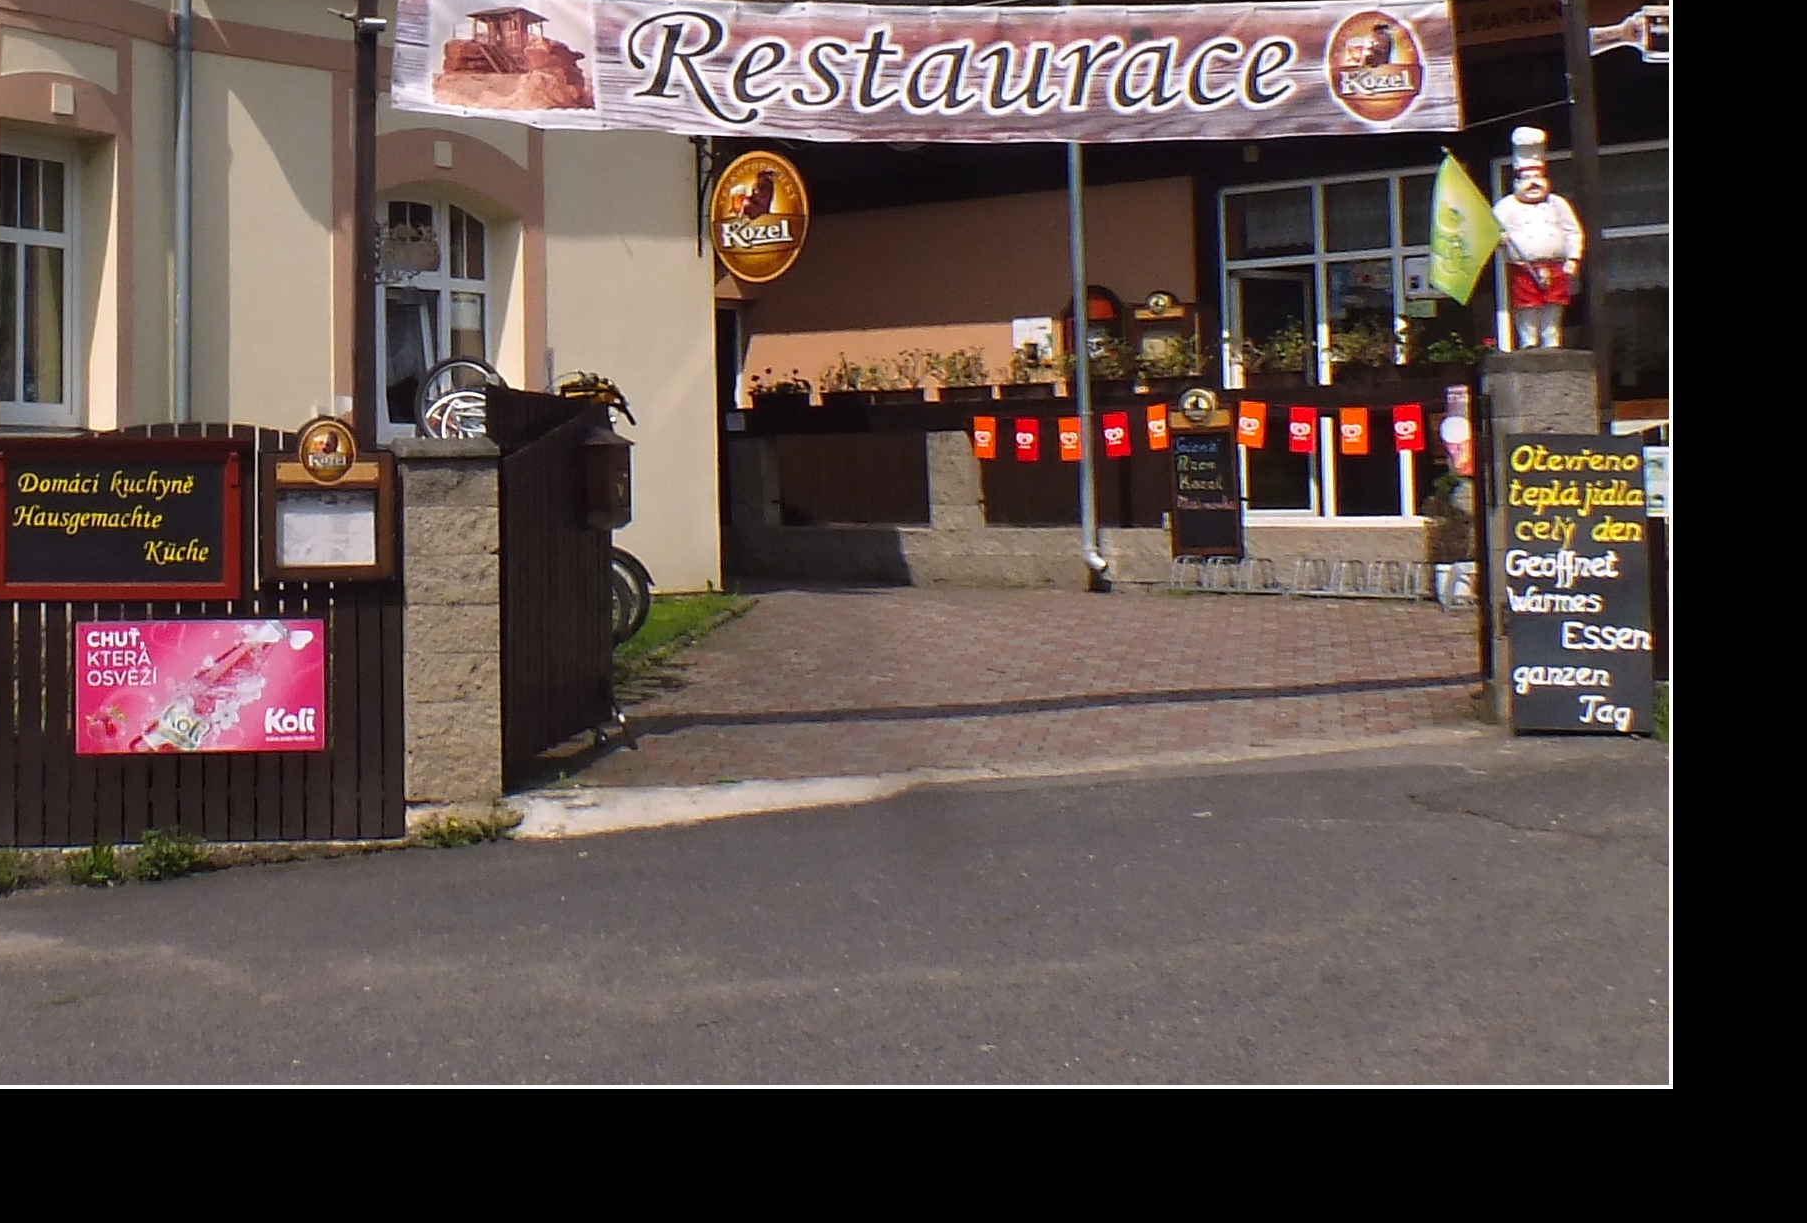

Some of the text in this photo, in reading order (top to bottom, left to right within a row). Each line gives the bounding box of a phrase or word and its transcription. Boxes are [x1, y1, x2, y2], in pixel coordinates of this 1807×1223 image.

[627, 10, 1294, 125] Restaurace
[1339, 70, 1415, 94] Kozel
[721, 219, 793, 247] Kozel
[110, 470, 194, 501] kuchyně
[12, 503, 164, 536] Hausgemachte
[1514, 515, 1643, 549] celý den
[143, 538, 209, 566] Küche
[1505, 548, 1621, 589] Geöffnet
[86, 627, 146, 649] CHUŤ,
[1560, 621, 1654, 651] Essen
[87, 647, 152, 667] KTERÁ
[1512, 665, 1612, 695] ganzen
[265, 707, 316, 733] Koli
[1578, 694, 1634, 733] Tag
